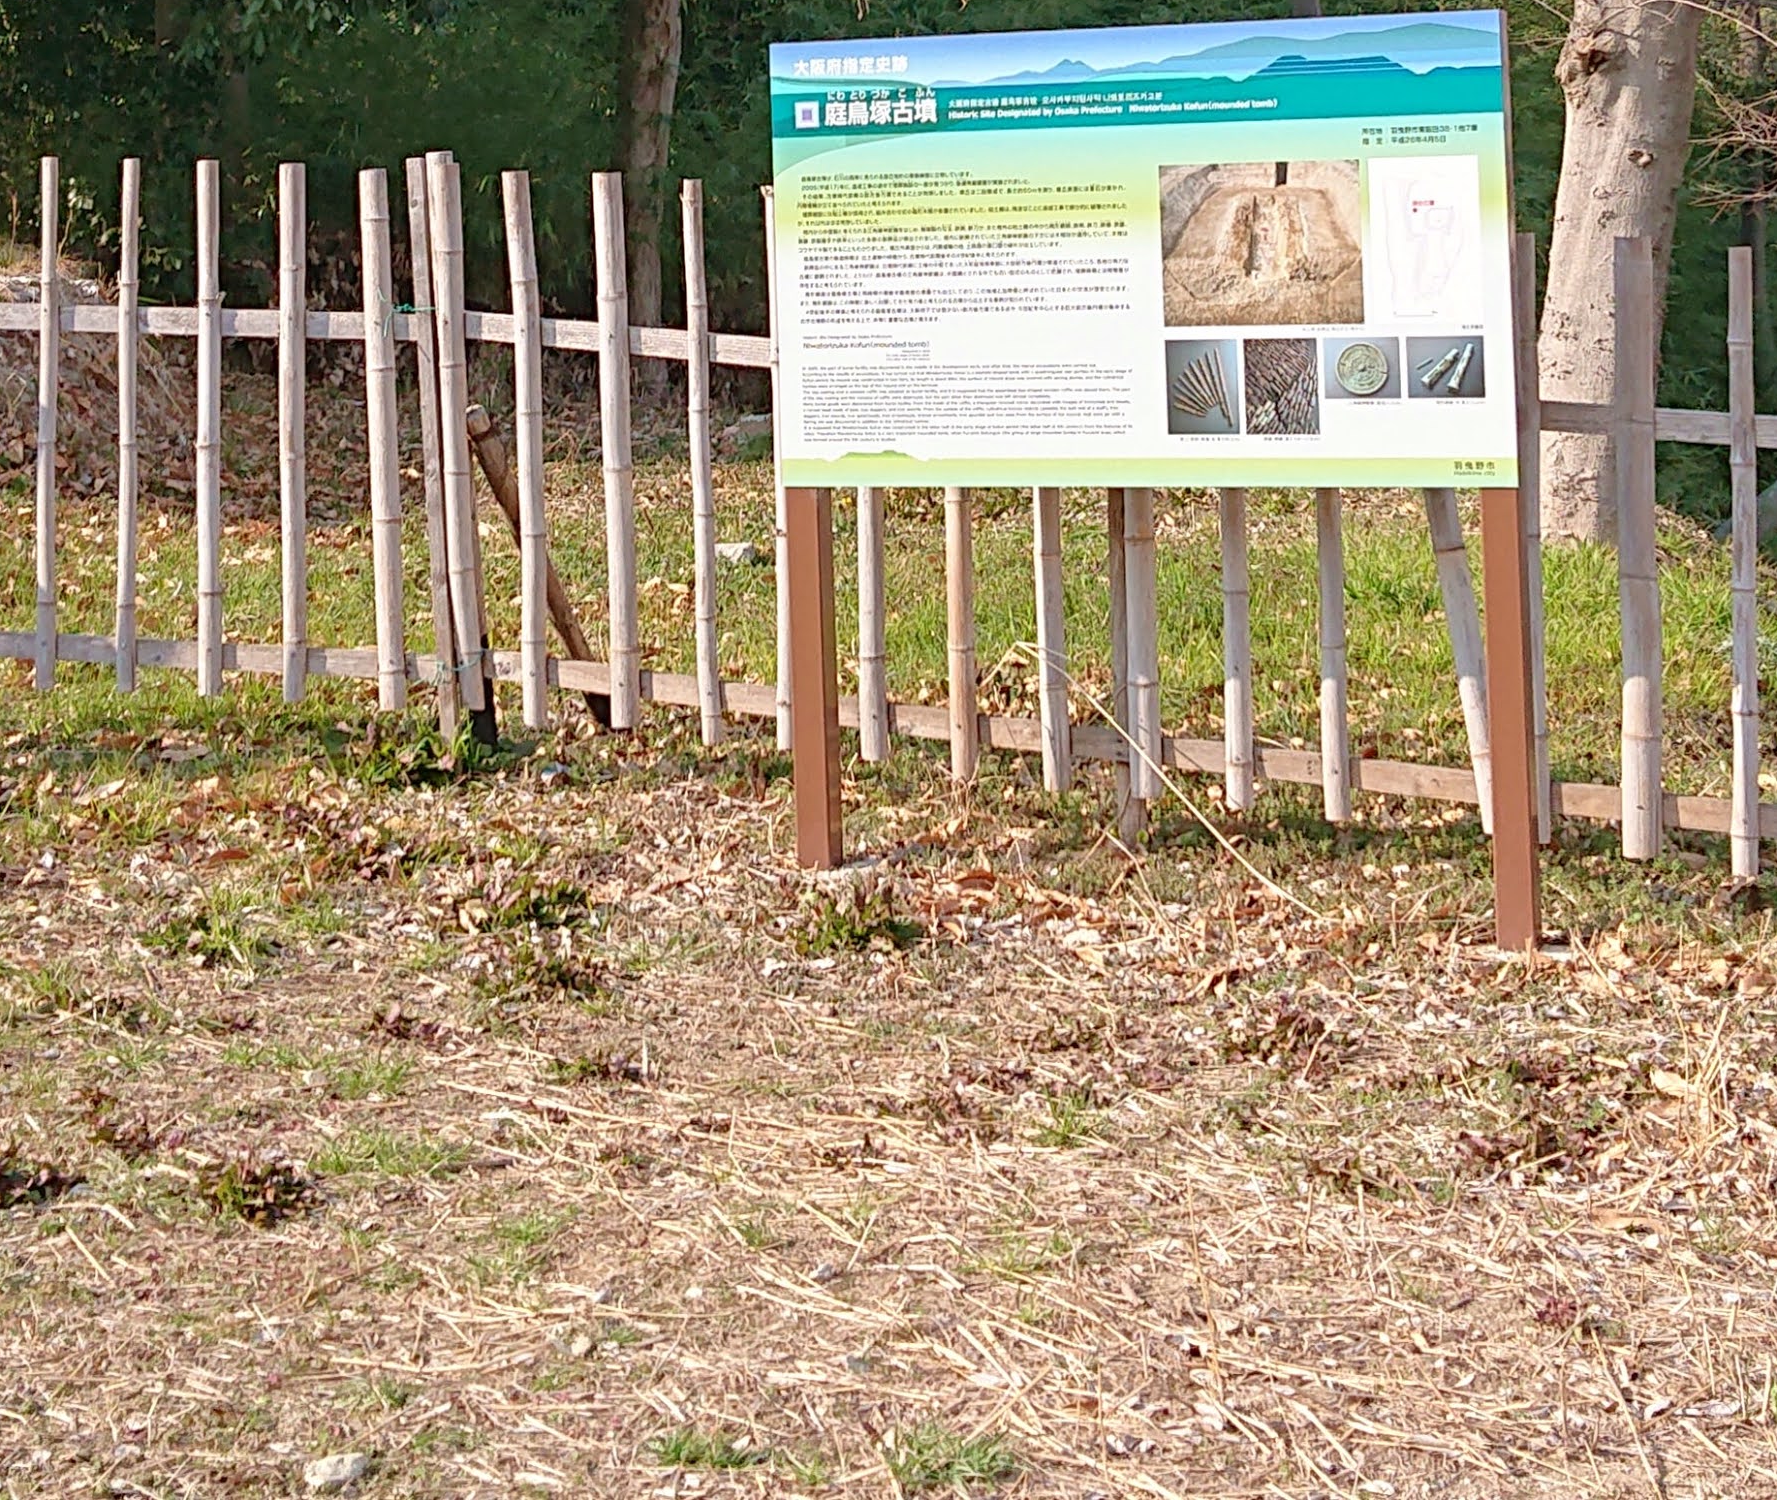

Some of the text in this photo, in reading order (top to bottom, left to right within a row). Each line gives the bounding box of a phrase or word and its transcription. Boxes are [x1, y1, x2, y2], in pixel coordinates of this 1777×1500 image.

[793, 54, 909, 76] 大阪府指定史跡
[824, 98, 938, 127] 庭鳥塚古墳
[948, 109, 979, 119] Historic
[980, 108, 996, 118] Site
[997, 107, 1042, 119] Designated
[1043, 106, 1053, 118] by
[1054, 106, 1080, 116] Osaka
[1080, 104, 1123, 114] Prefecture
[1129, 102, 1183, 113] Niwatorizuka
